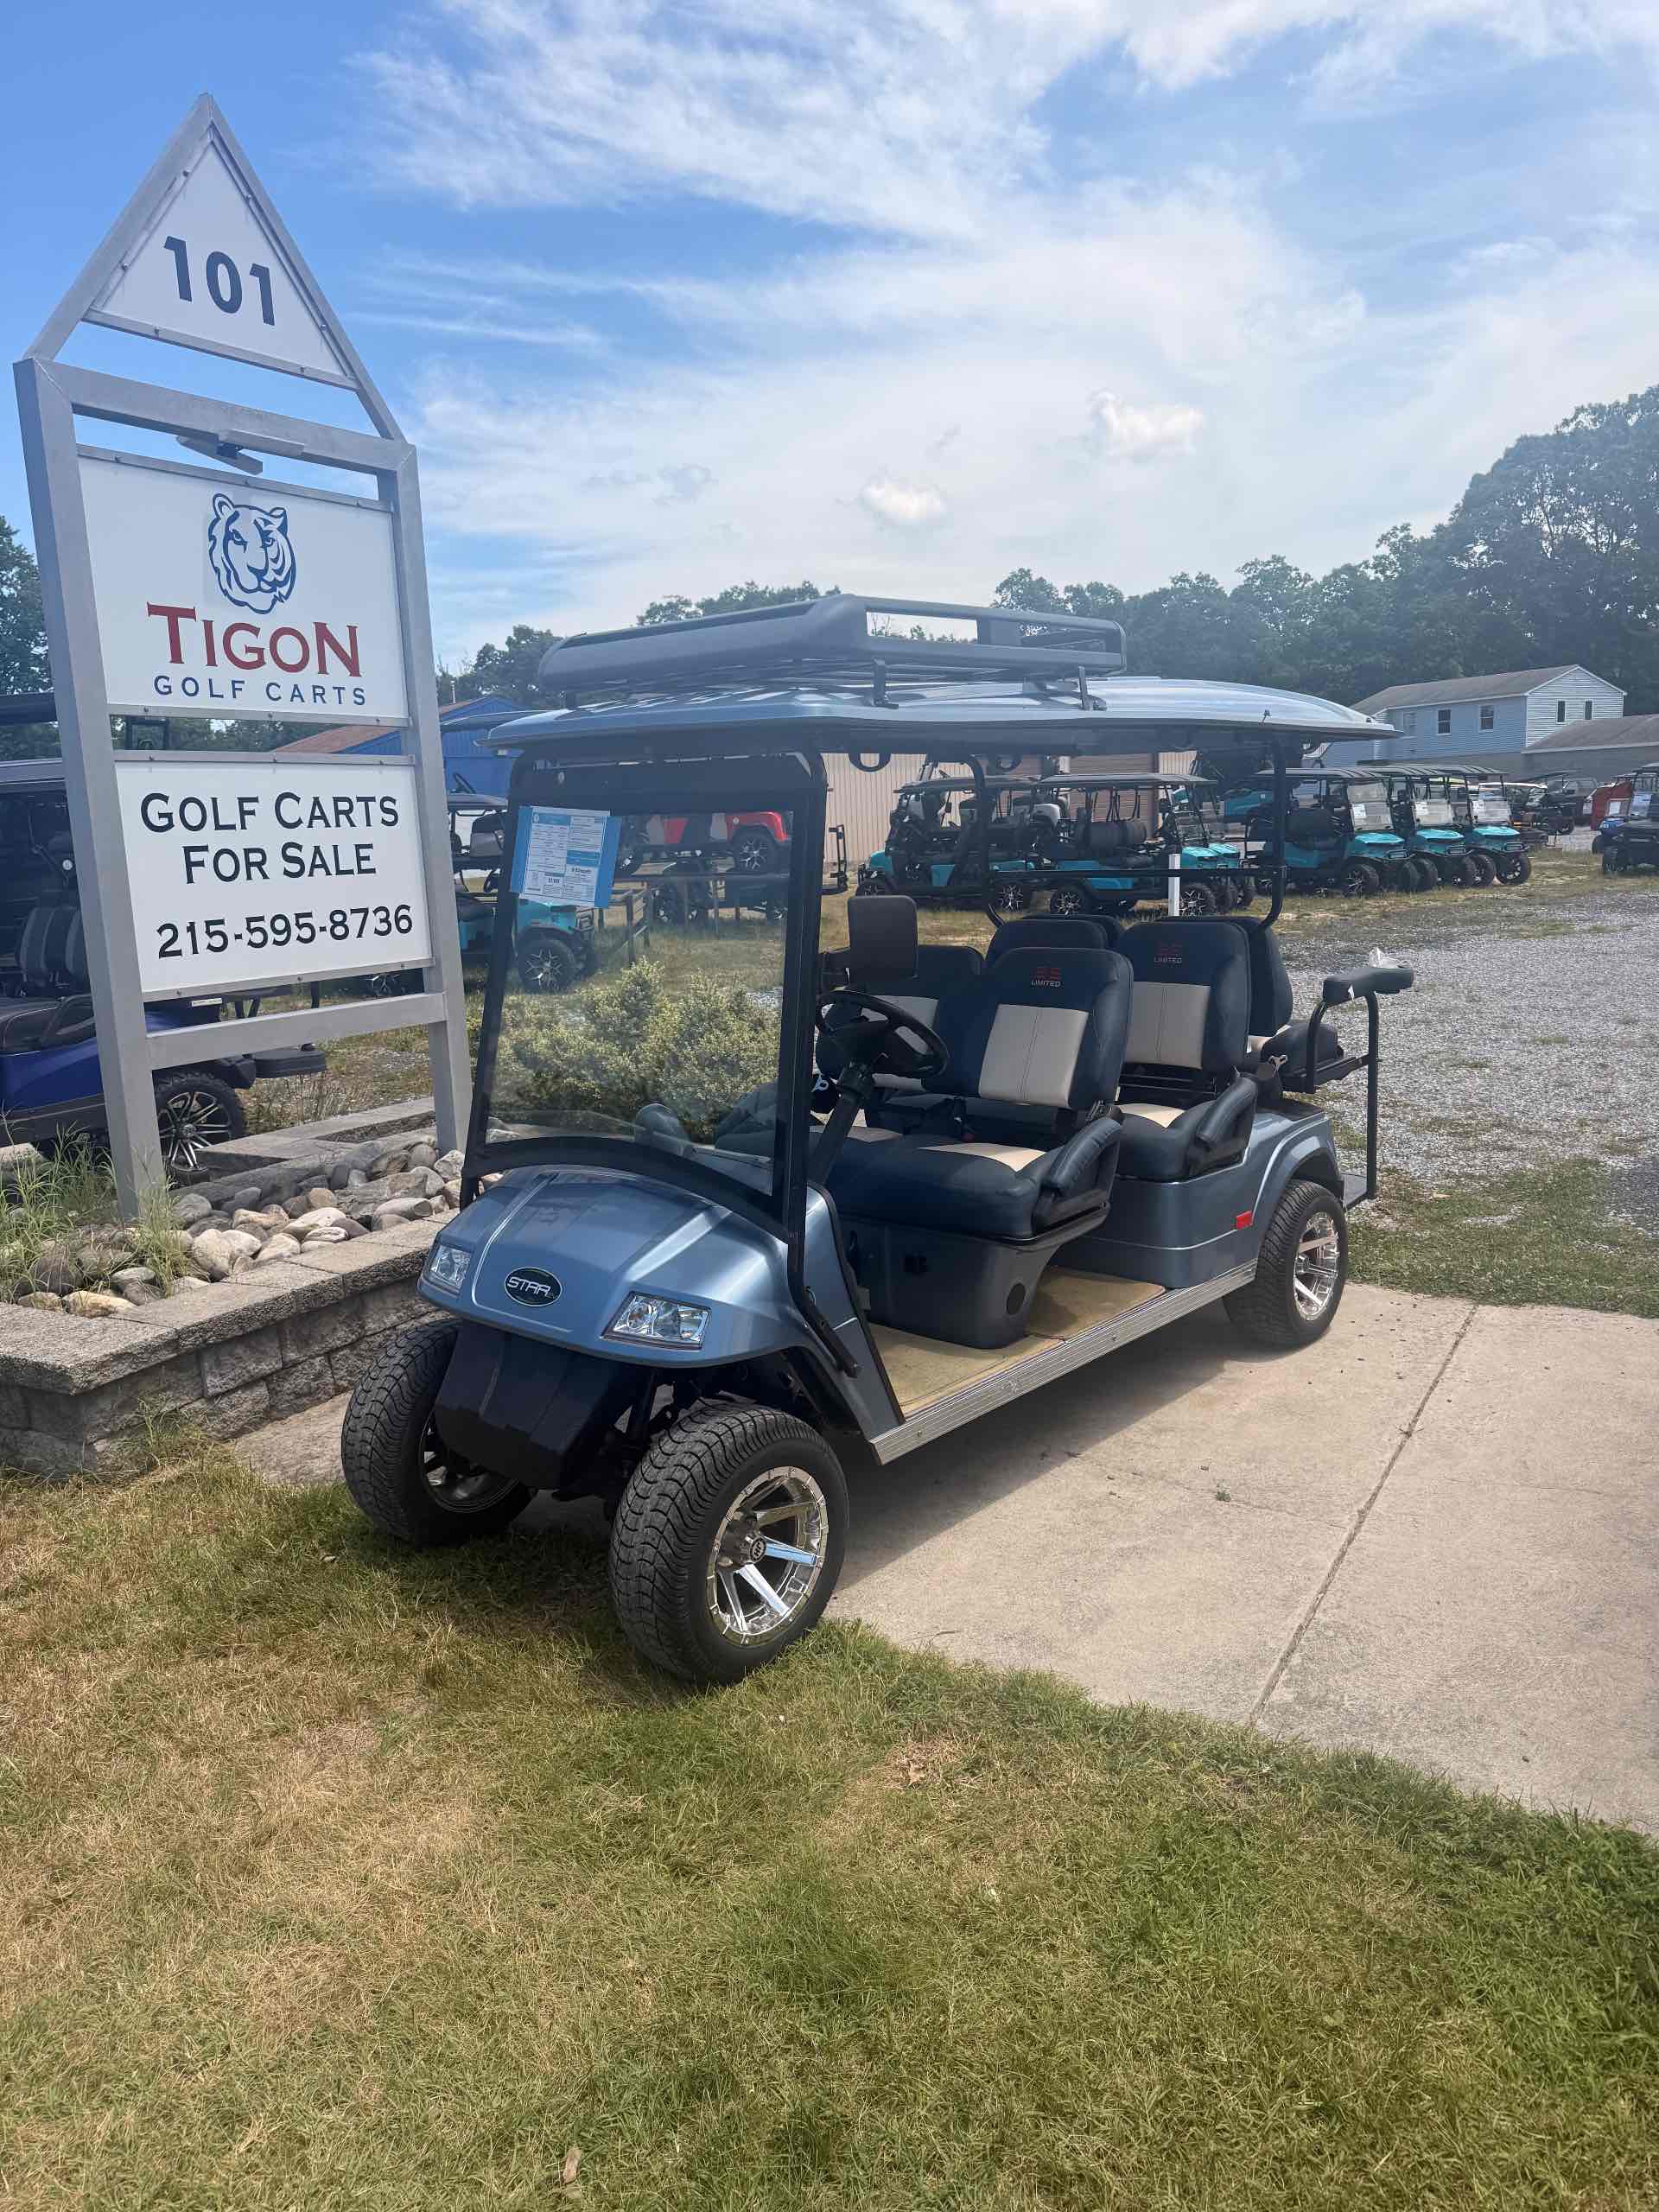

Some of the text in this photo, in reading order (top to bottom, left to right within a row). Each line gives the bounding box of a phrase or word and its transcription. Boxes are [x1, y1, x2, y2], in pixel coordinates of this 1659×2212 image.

[164, 235, 276, 327] 101
[146, 601, 361, 677] TIGON
[154, 675, 366, 706] GOLF CARTS
[140, 791, 400, 833] GOLF CARTS
[181, 842, 377, 885] FOR SALE
[156, 903, 414, 959] 215-595-8736
[506, 1276, 552, 1297] STAR
